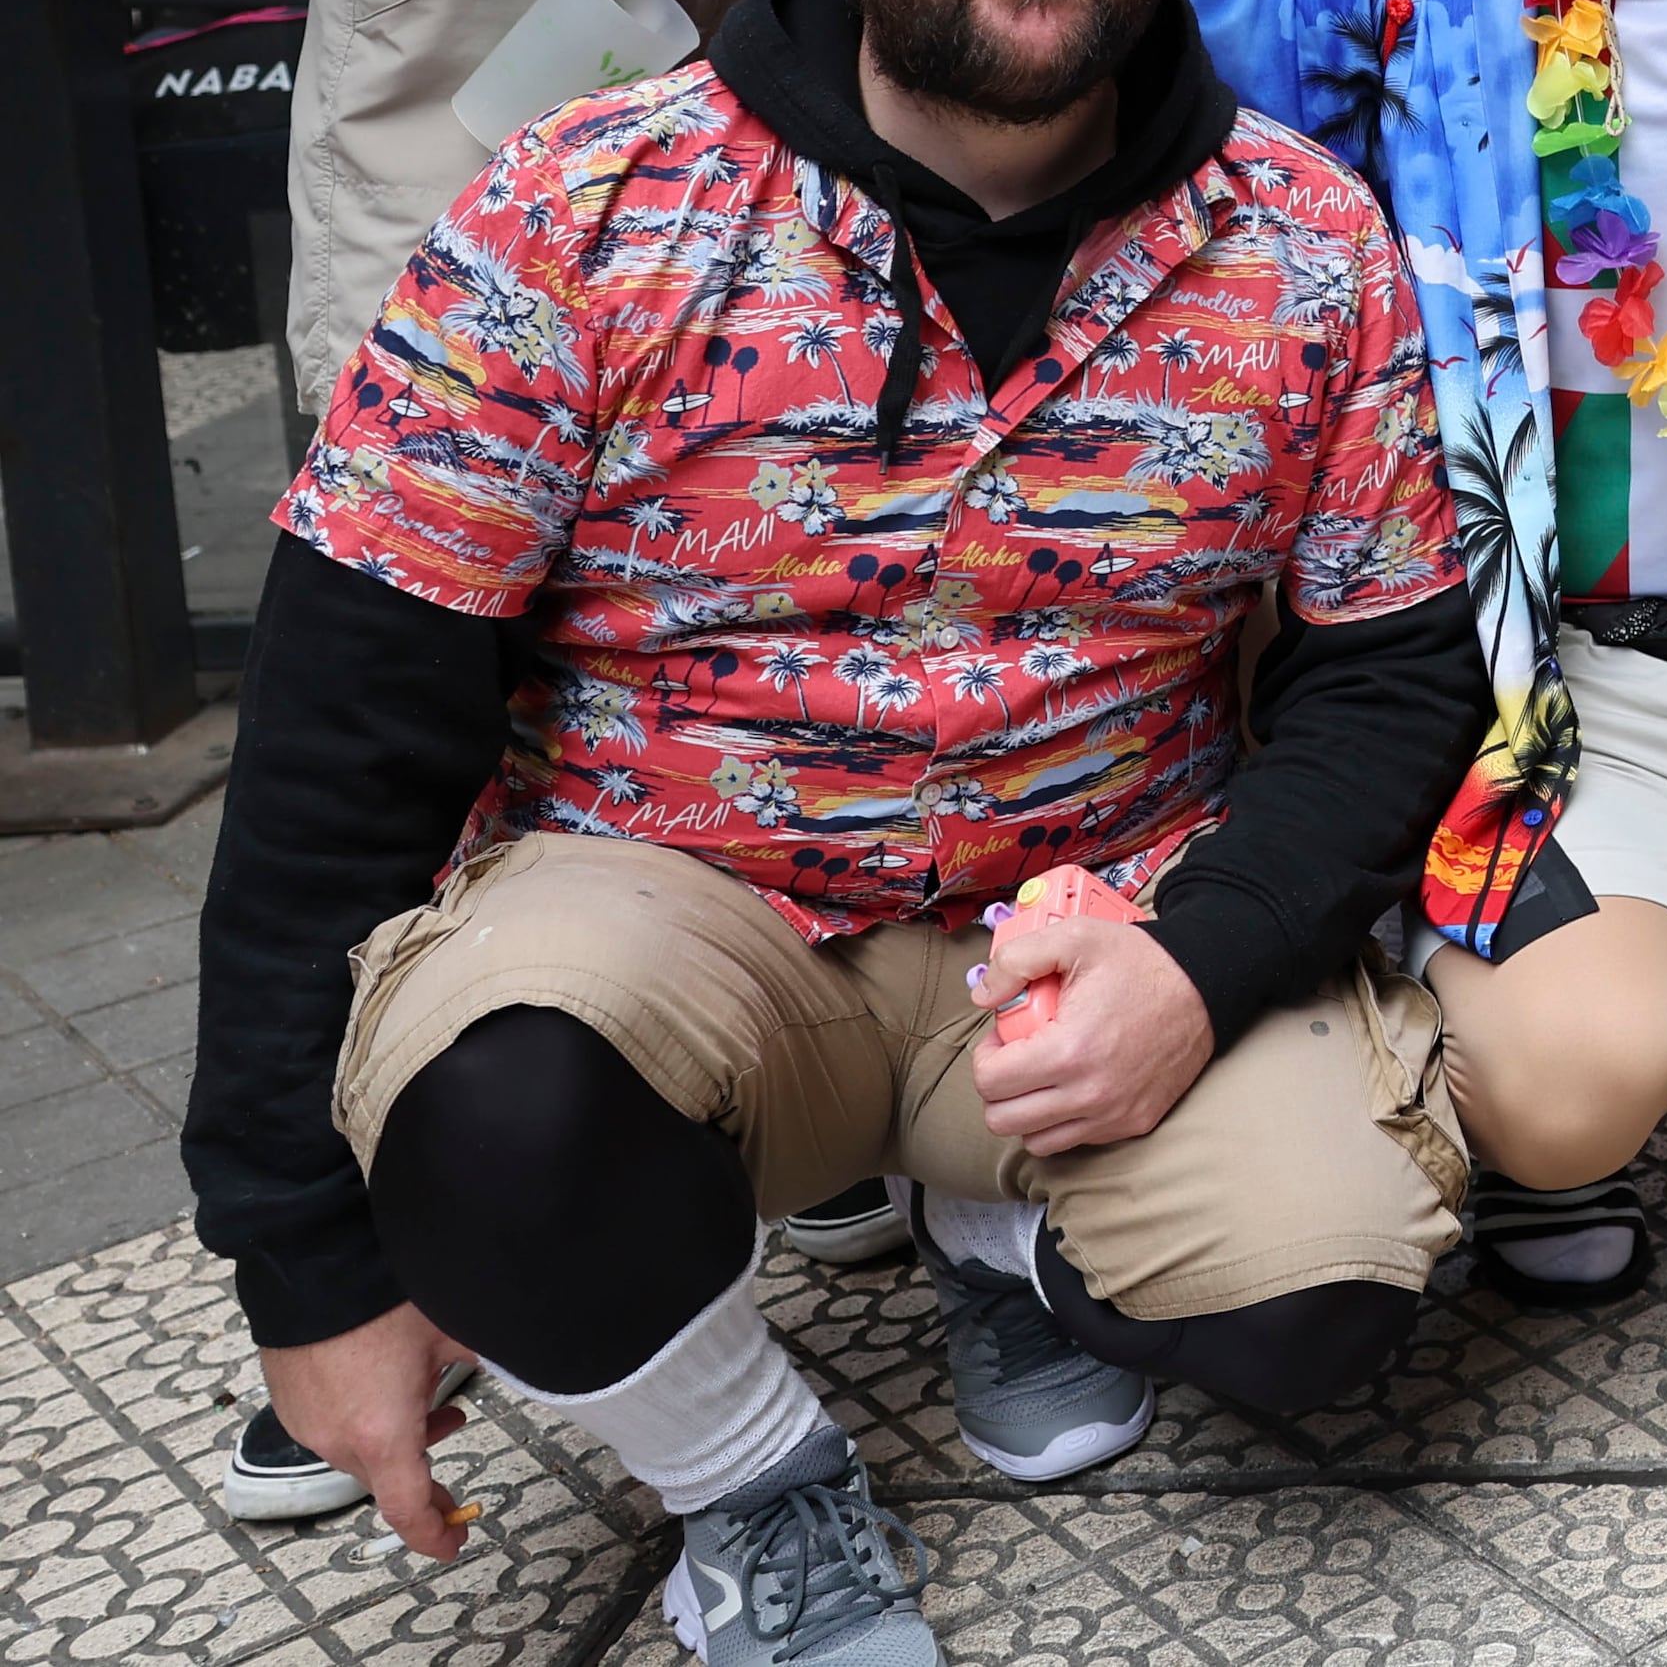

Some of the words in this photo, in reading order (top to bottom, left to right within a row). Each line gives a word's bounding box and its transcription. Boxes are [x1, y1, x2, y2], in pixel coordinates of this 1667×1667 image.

[154, 60, 293, 99] NABA
[1185, 375, 1276, 407] Aloha
[1318, 448, 1402, 506] MAUI
[369, 493, 495, 560] Paradise
[670, 514, 776, 564] MAUI
[751, 552, 848, 585] Aloha
[942, 540, 1026, 571] Aloha
[584, 651, 649, 688] Aloha
[1138, 648, 1198, 686] Aloha
[625, 801, 732, 835] MAUI
[940, 834, 1016, 876] Aloha
